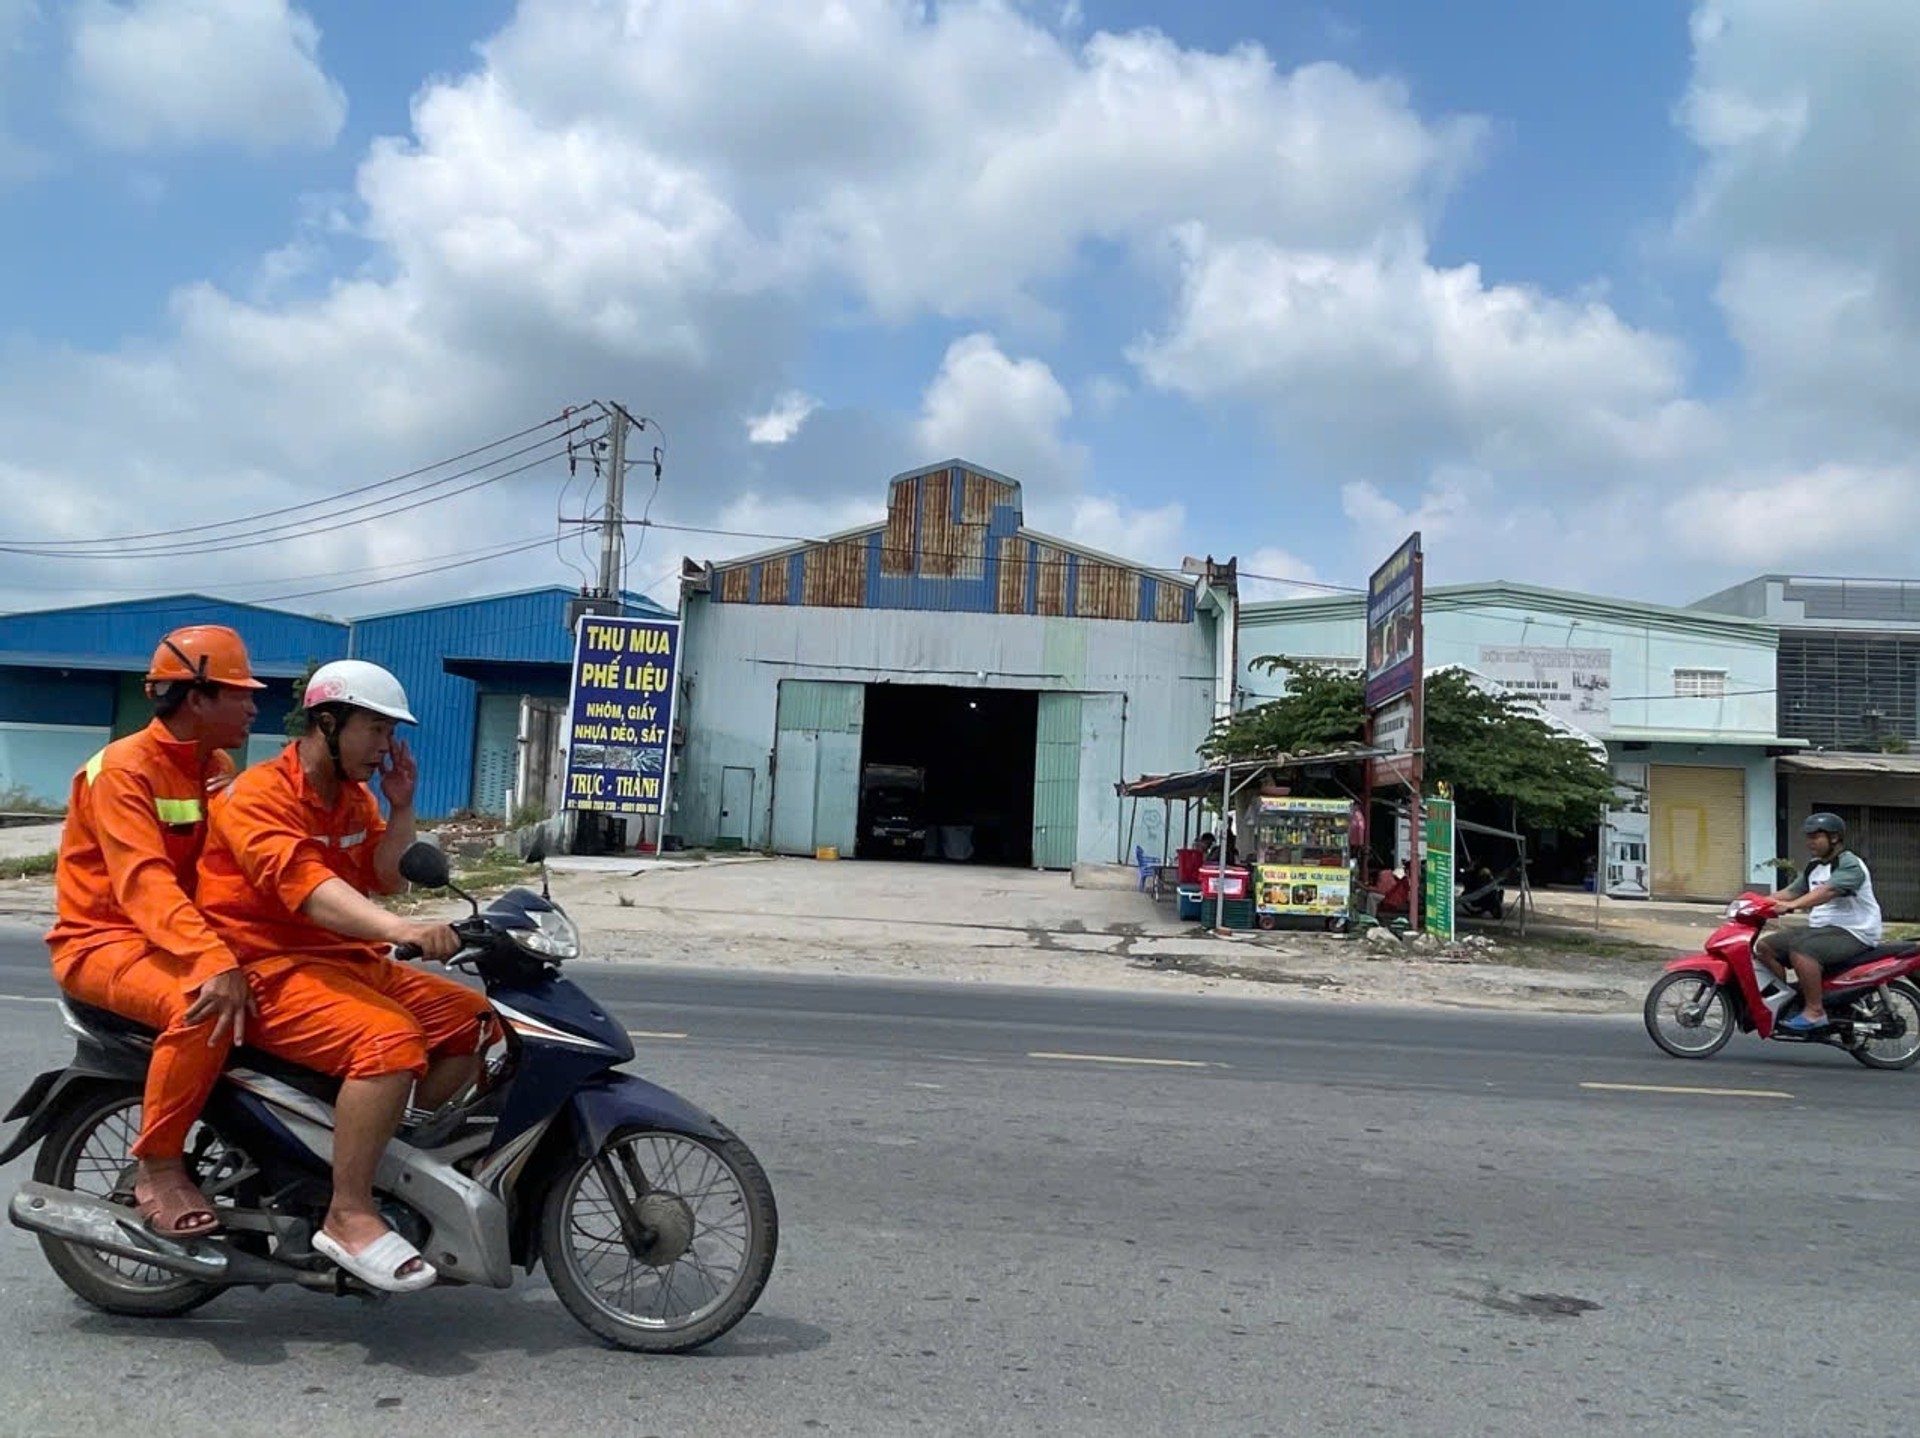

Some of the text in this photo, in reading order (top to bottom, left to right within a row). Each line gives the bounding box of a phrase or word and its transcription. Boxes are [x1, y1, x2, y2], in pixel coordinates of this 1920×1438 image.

[587, 625, 670, 655] THU MUA
[581, 654, 668, 698] PHẾ LIỆU
[586, 700, 657, 722] NHÔM, GIẤY
[574, 722, 608, 744] NHỰA
[641, 722, 665, 744] SẮT
[571, 773, 605, 800] TRỰC
[616, 771, 660, 799] THÀNH
